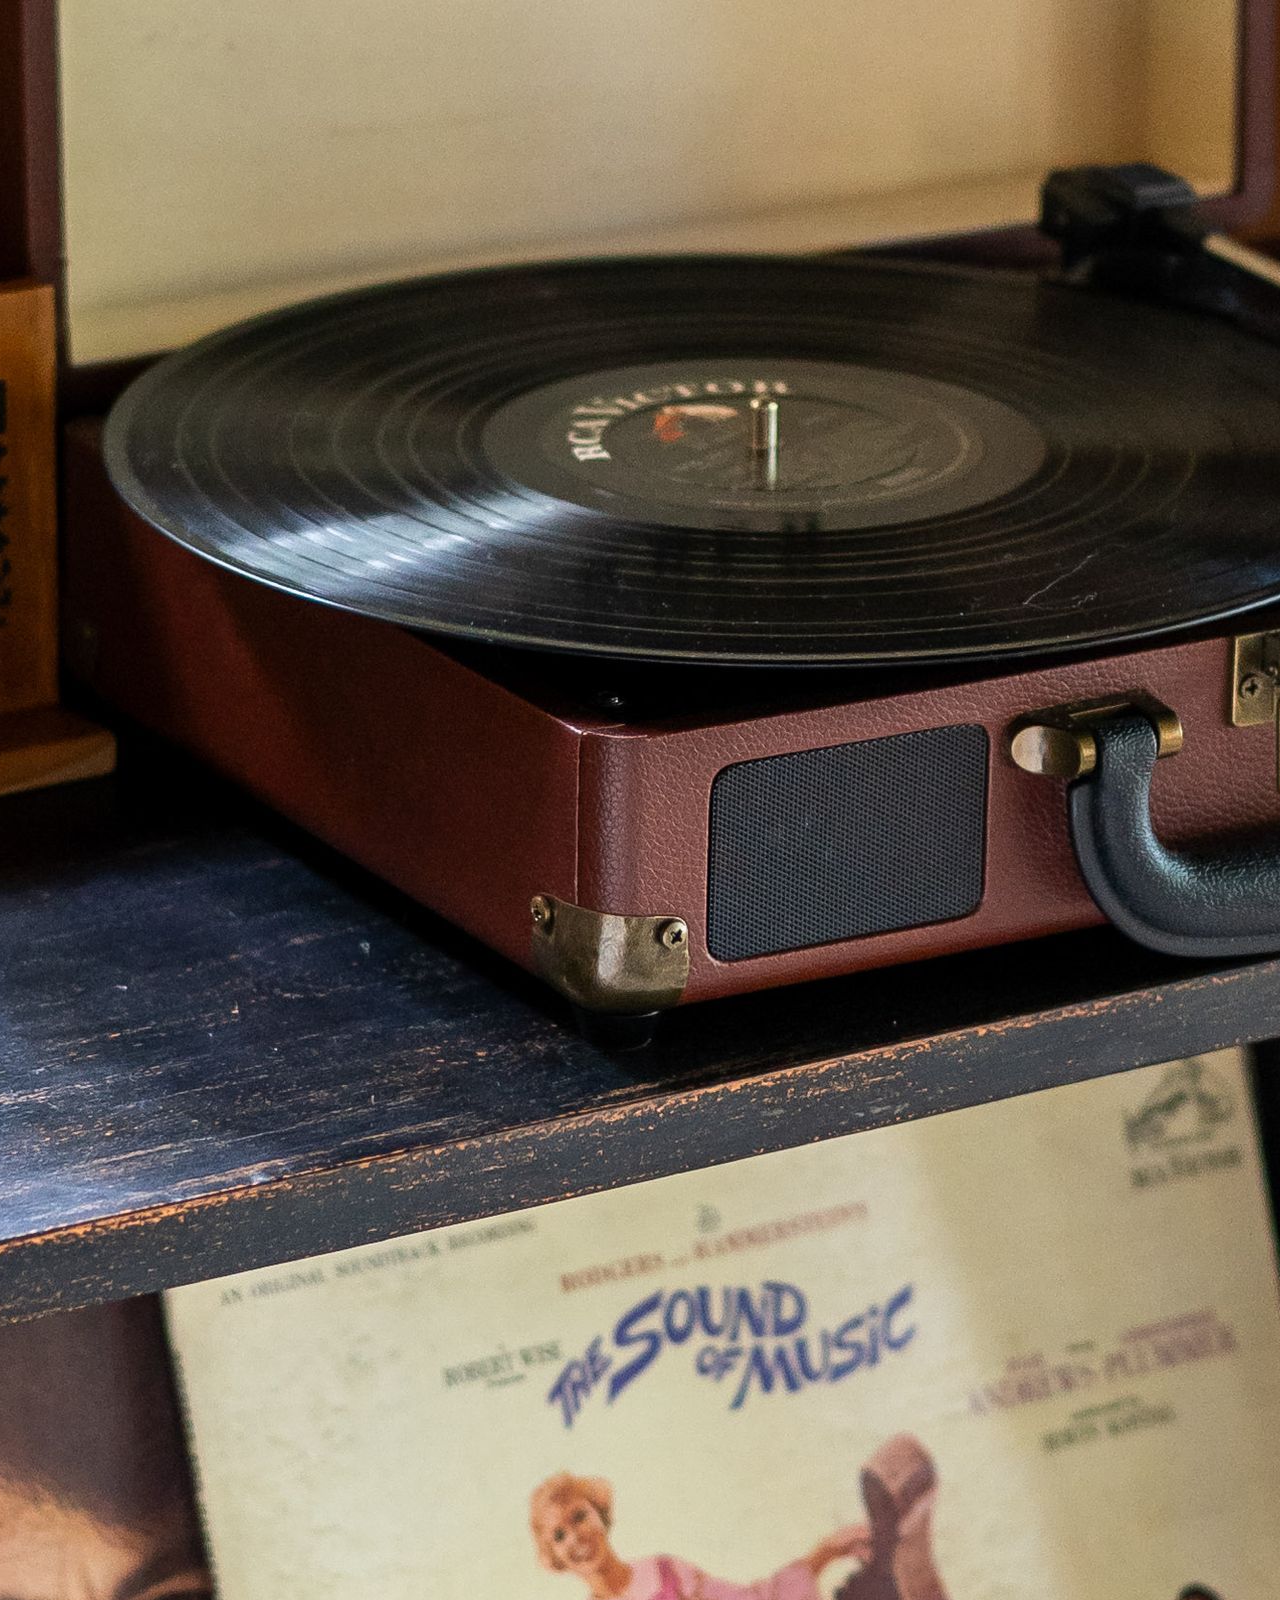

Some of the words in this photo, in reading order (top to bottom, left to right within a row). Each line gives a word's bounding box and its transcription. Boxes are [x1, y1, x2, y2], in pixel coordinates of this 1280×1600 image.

[606, 1280, 808, 1404] SOUND
[694, 1344, 743, 1381] OF
[728, 1282, 917, 1412] MUSIC
